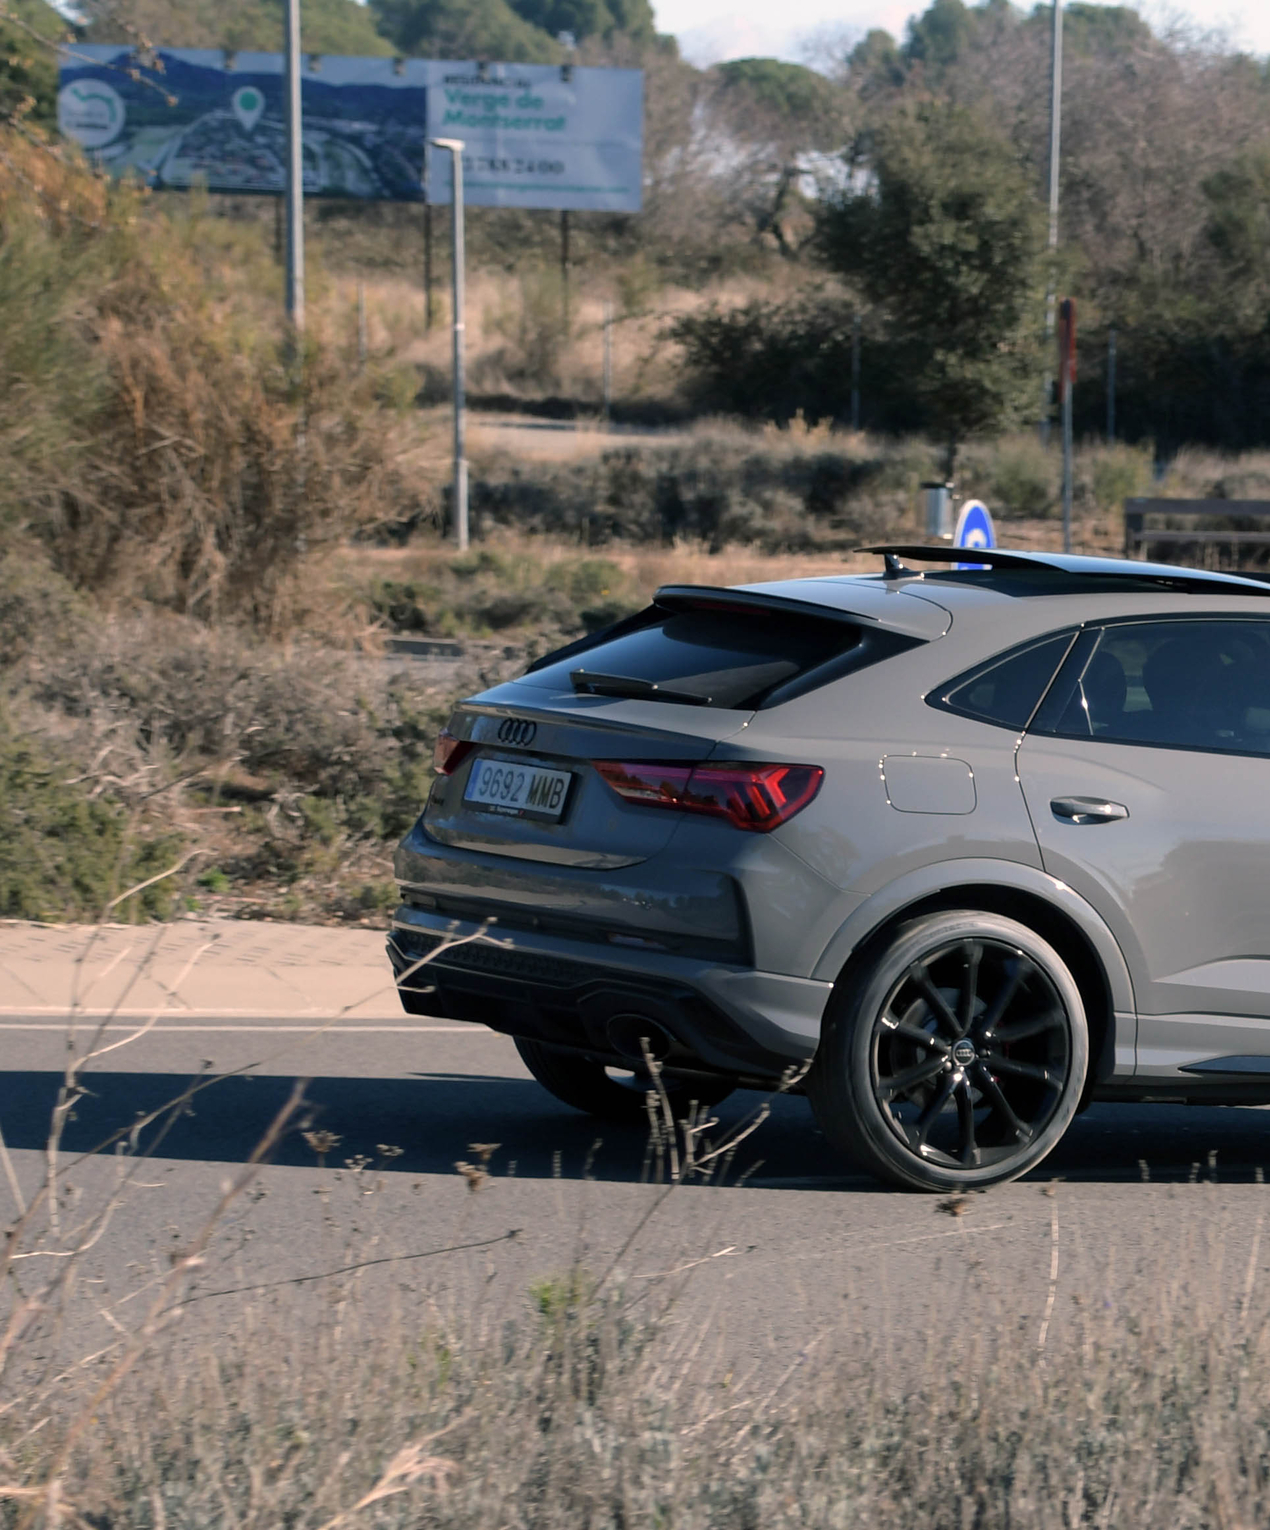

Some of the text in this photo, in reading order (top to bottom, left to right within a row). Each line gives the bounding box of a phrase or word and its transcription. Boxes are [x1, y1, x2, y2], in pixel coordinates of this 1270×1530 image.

[444, 89, 544, 112] Verge de
[444, 110, 566, 130] Montserrat
[478, 767, 565, 809] 9692 MMB
